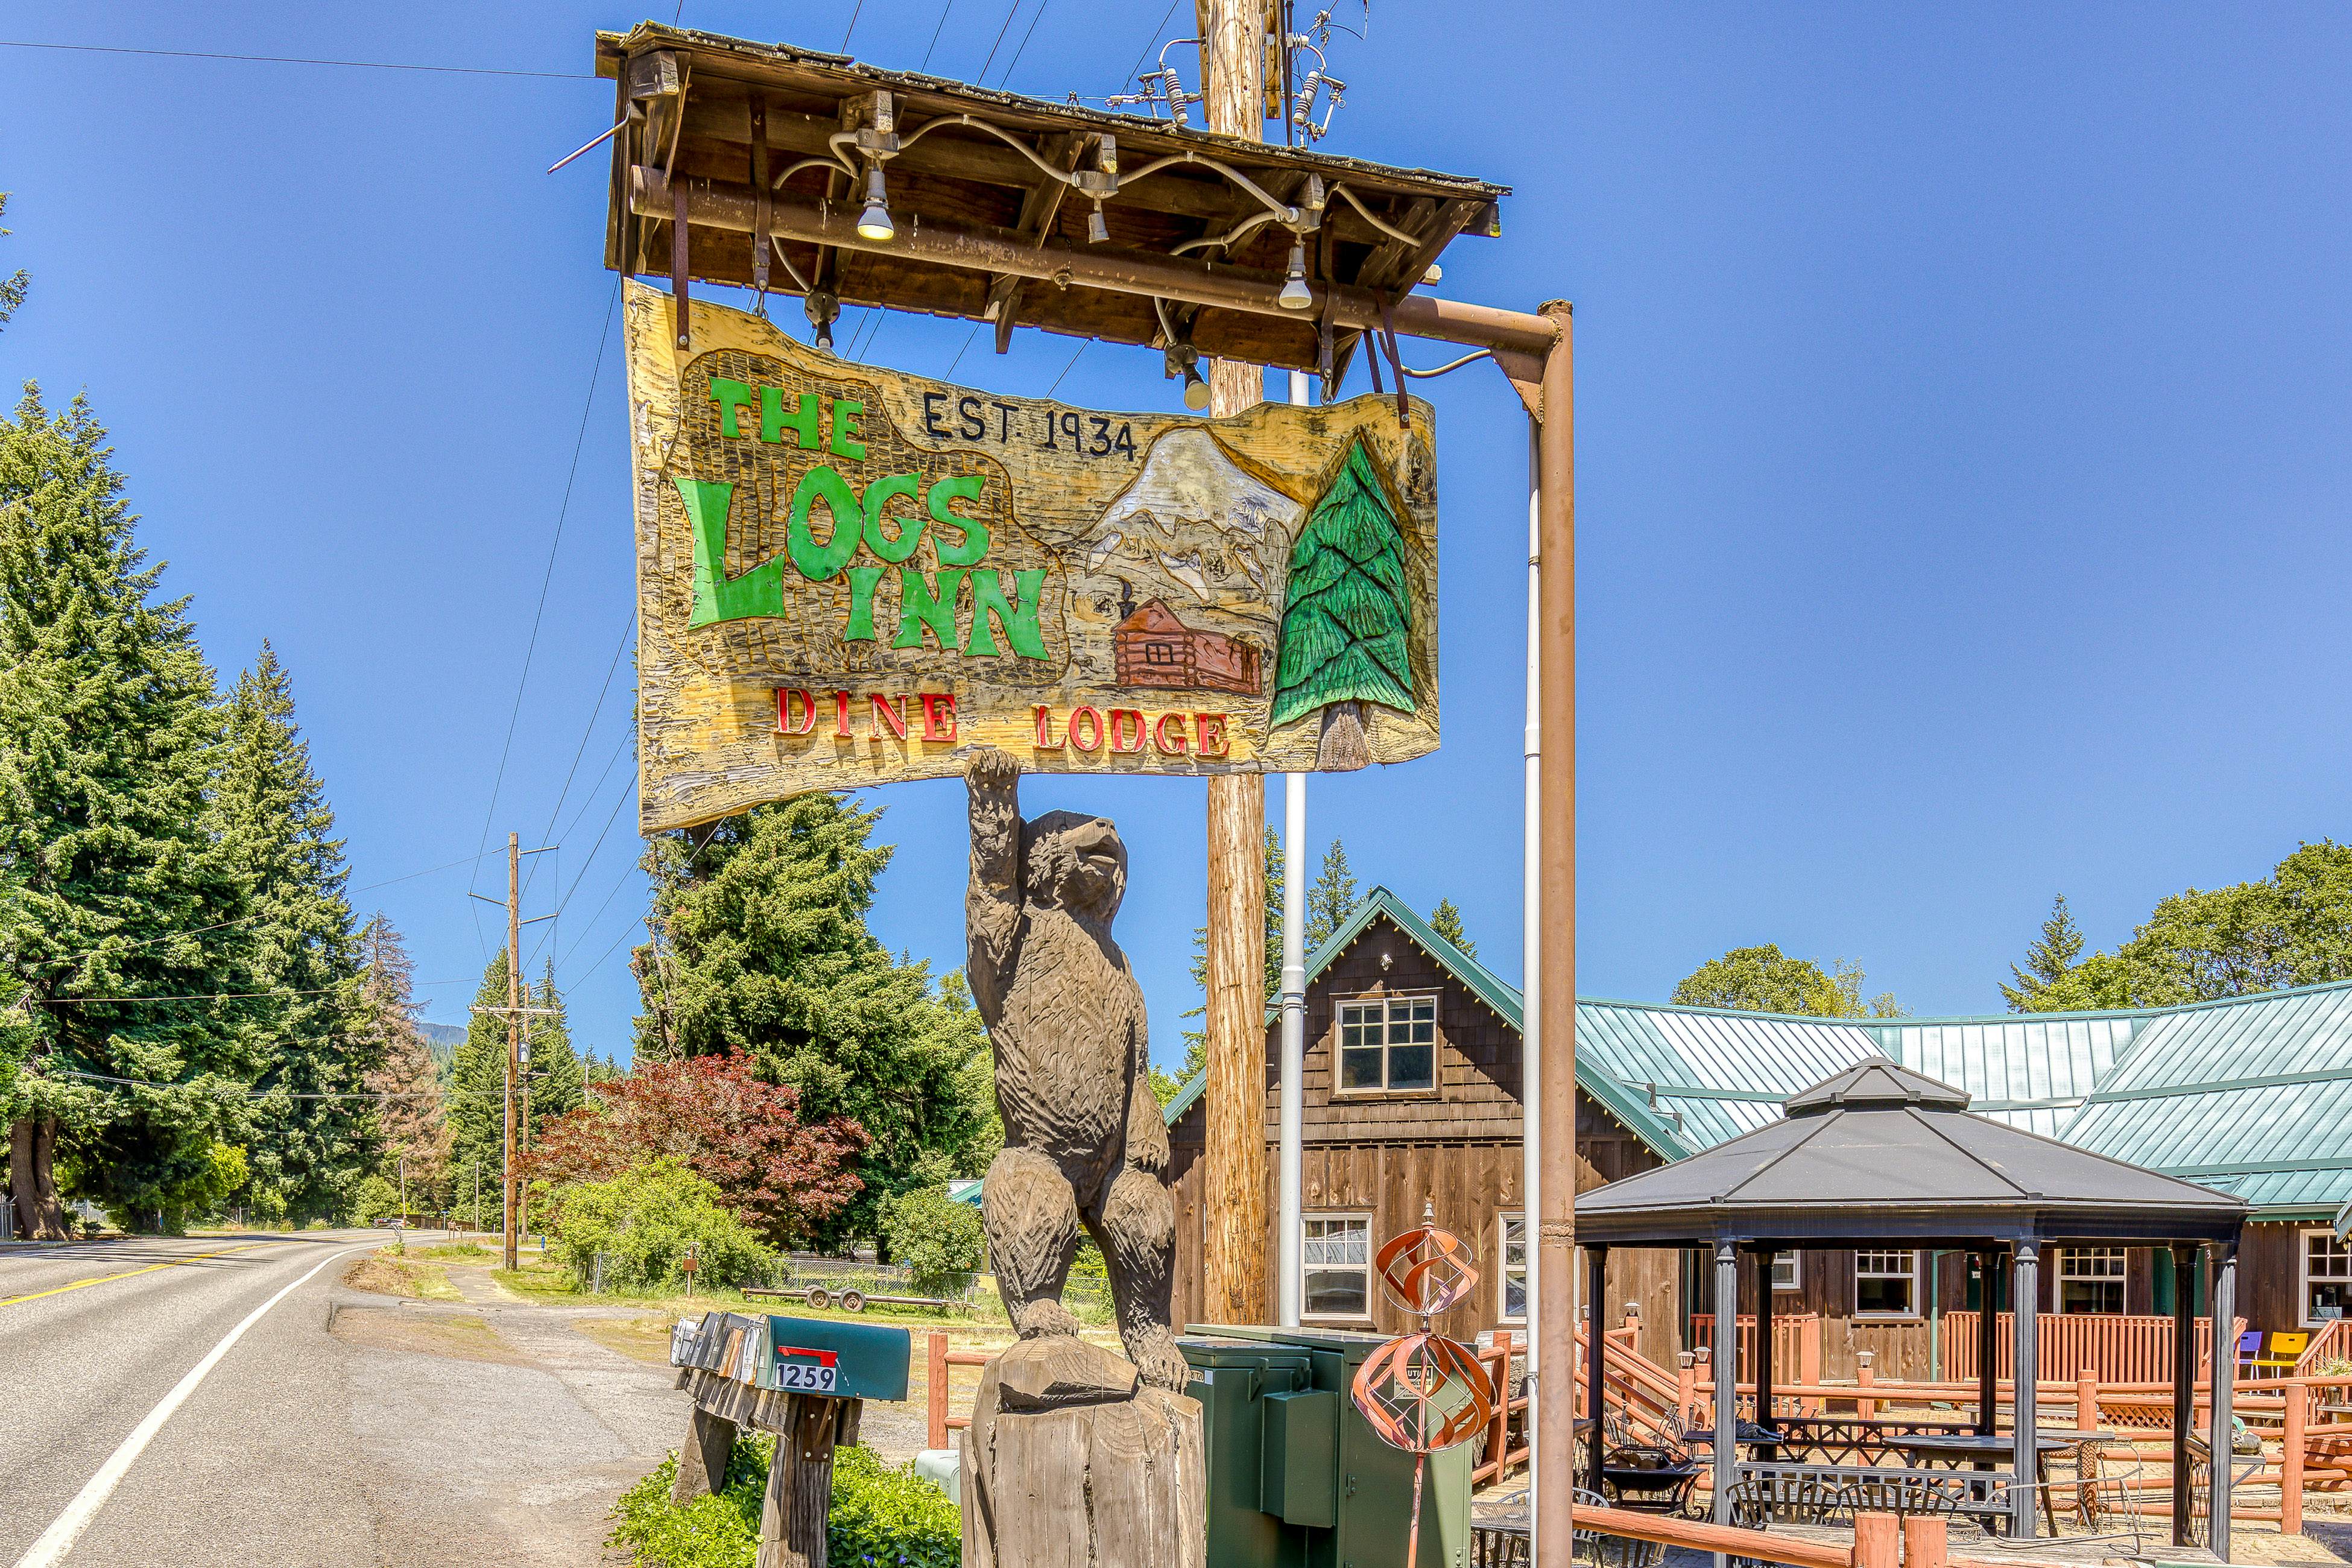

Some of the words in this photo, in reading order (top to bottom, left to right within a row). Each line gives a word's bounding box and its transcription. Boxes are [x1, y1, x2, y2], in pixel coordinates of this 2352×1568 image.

[709, 377, 865, 462] THE
[923, 391, 1022, 444] EST.
[1043, 410, 1137, 461] 1934
[672, 465, 990, 631] LOGS
[843, 566, 1051, 660] INN
[773, 687, 957, 742] DINE
[1031, 703, 1230, 757] LODGE
[2206, 1249, 2211, 1259] 3
[778, 1364, 834, 1389] 1259
